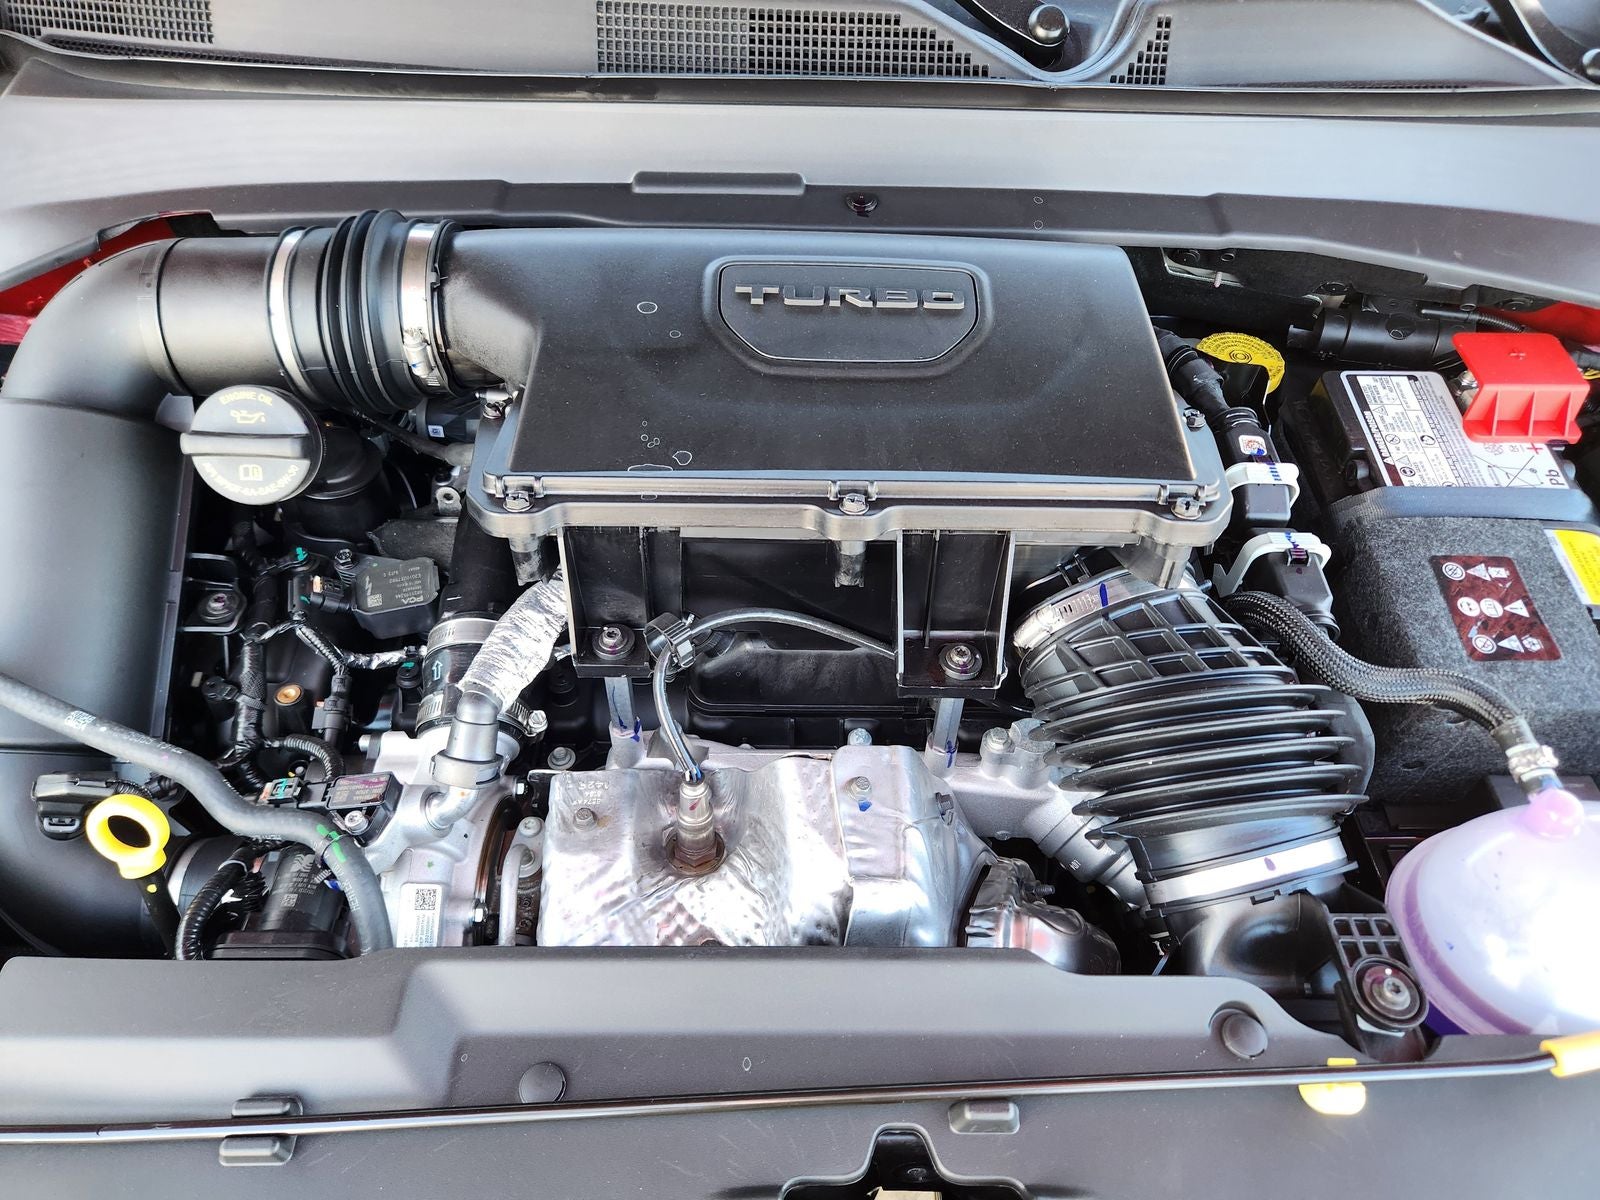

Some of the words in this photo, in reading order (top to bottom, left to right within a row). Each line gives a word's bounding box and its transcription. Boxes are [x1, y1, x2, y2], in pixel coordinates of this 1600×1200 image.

[734, 284, 965, 310] TURBO
[219, 391, 257, 405] ENGINE
[258, 393, 273, 406] OIL
[1545, 469, 1566, 486] Pb
